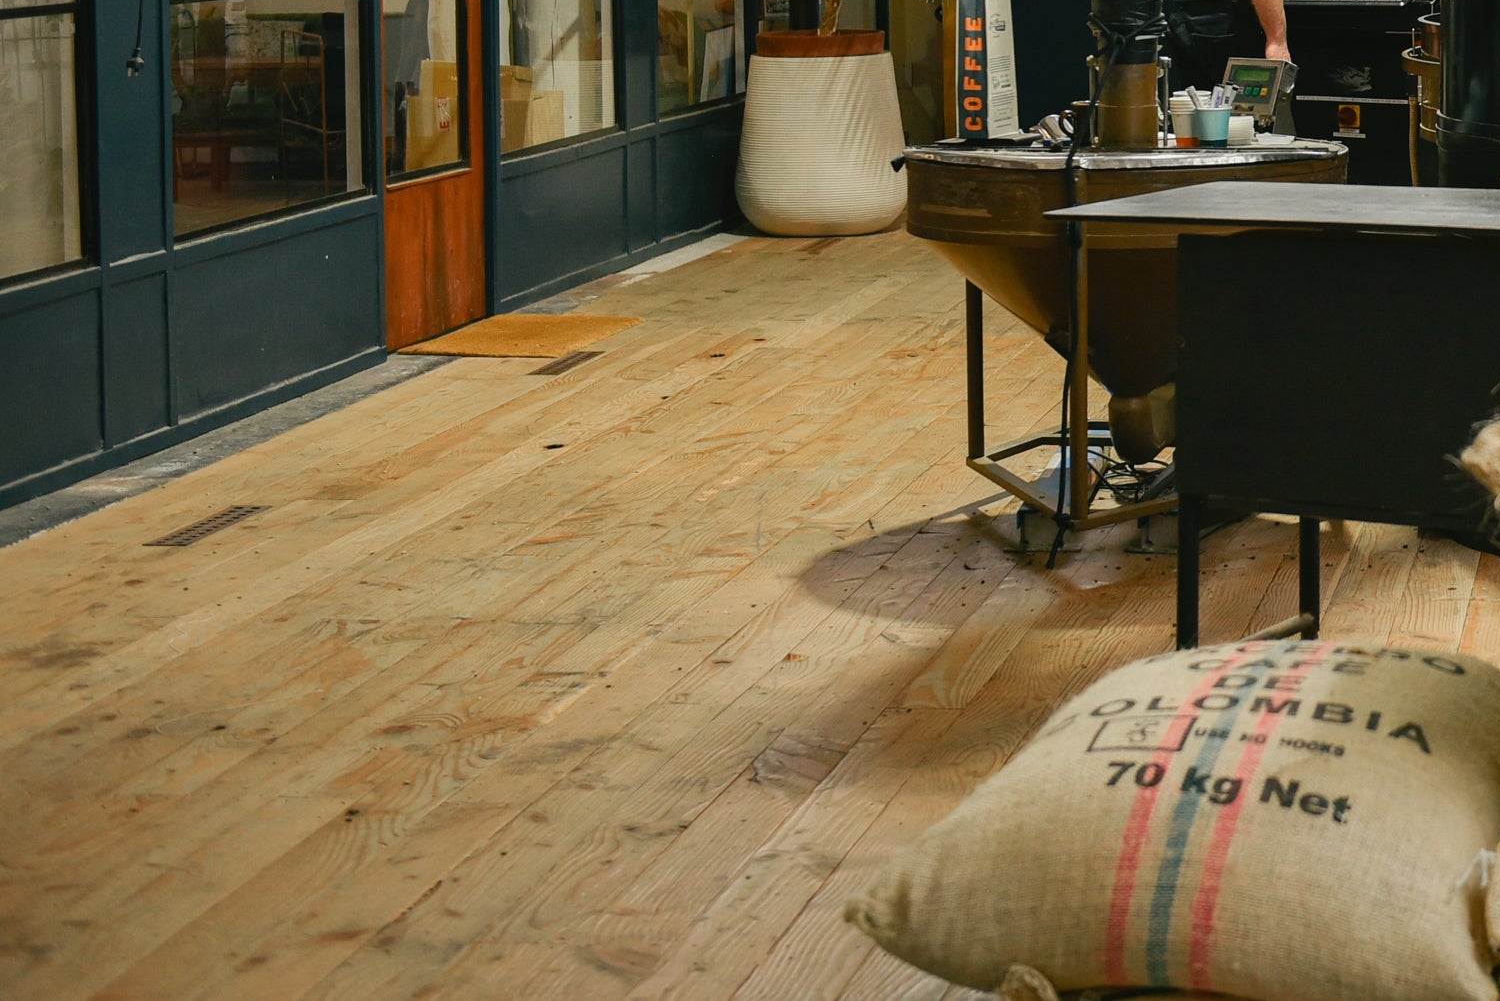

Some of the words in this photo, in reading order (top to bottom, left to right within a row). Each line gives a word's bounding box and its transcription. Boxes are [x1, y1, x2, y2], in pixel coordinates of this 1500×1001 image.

[963, 16, 983, 132] COFFEE
[1213, 675, 1305, 691] DE
[1195, 727, 1230, 741] USE
[1239, 733, 1267, 746] NO
[1279, 738, 1346, 757] HOOKS
[1106, 761, 1167, 789] 70
[1180, 765, 1244, 806] kg
[1259, 777, 1354, 826] Net
